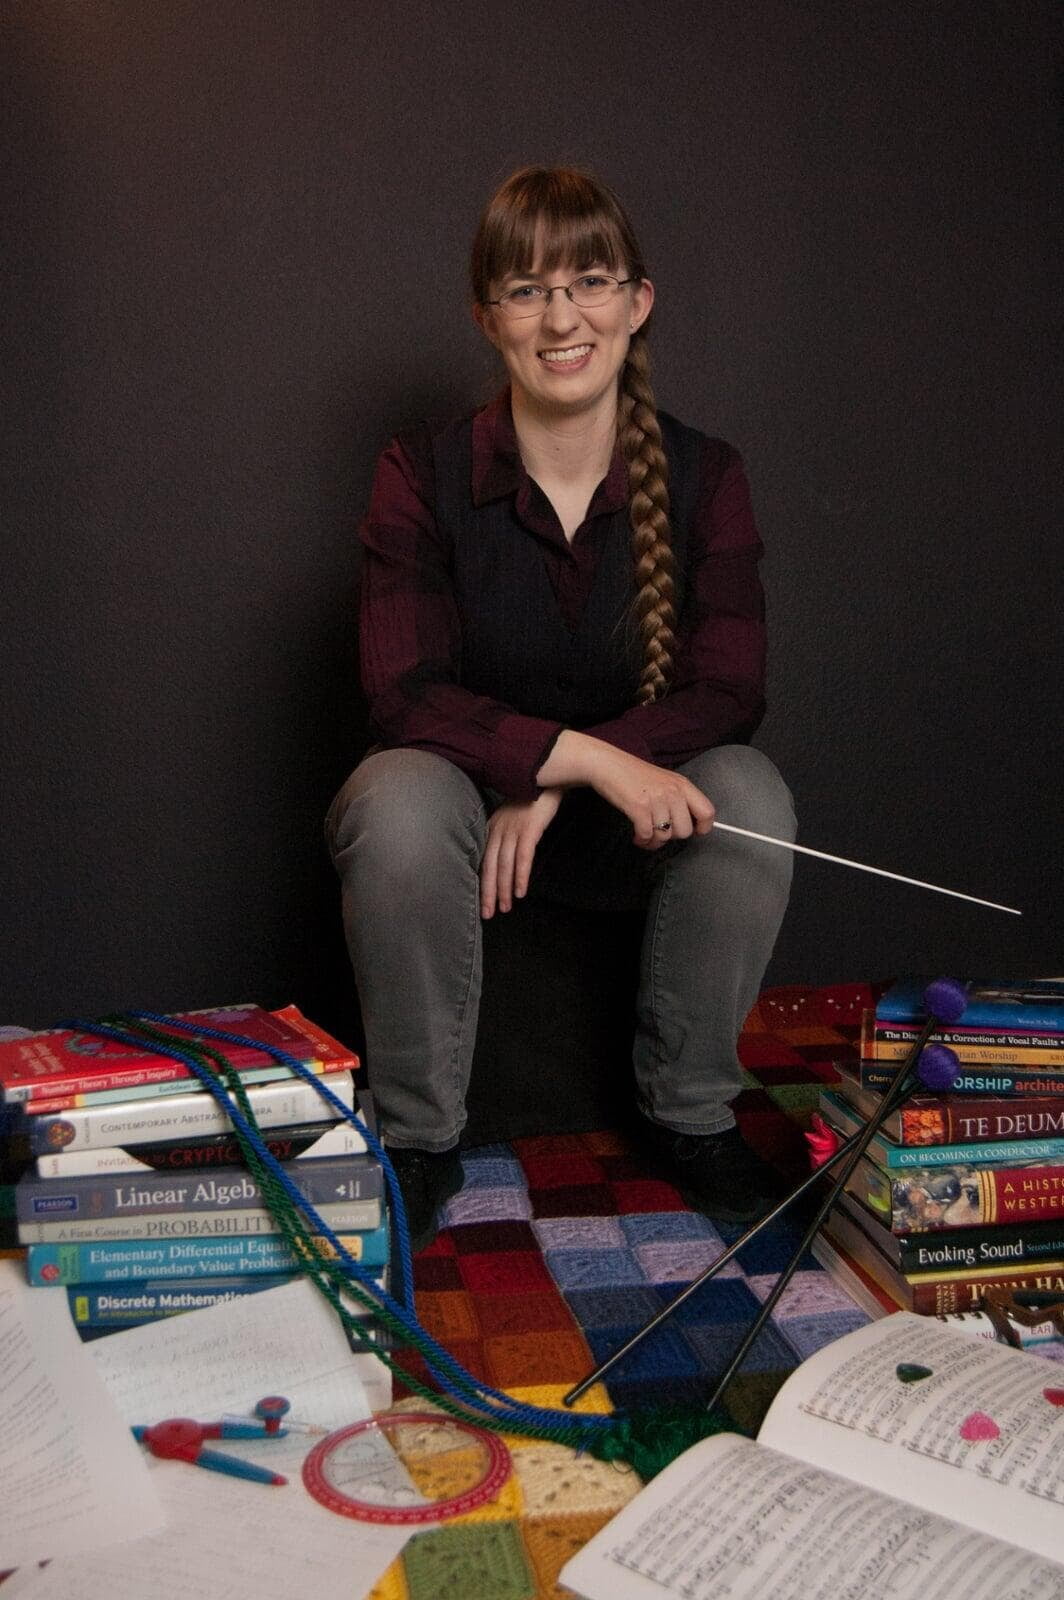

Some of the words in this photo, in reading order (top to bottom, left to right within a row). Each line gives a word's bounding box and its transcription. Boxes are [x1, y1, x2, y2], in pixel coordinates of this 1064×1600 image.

[885, 1031, 900, 1039] The
[902, 1032, 942, 1041] Diagsis
[944, 1033, 951, 1042] &
[952, 1034, 996, 1044] Correction
[997, 1035, 1006, 1043] of
[1008, 1037, 1030, 1045] Vocal
[1032, 1038, 1059, 1046] Faults
[979, 1051, 1018, 1061] Worship
[79, 1077, 107, 1090] Theory
[111, 1072, 145, 1085] Through
[147, 1067, 177, 1081] Inquiry
[953, 1077, 1012, 1090] ORSHIP
[101, 1116, 178, 1133] CONTEMPORARY
[960, 1117, 989, 1137] TE
[996, 1112, 1064, 1135] DEUM
[900, 1153, 916, 1163] ON
[919, 1149, 974, 1162] BECOMING
[976, 1149, 983, 1158] A
[984, 1145, 1050, 1158] CONDUCTOR
[115, 1185, 187, 1208] Linear
[193, 1178, 259, 1204] Algeb
[1004, 1182, 1015, 1194] A
[58, 1230, 66, 1240] A
[146, 1215, 277, 1236] PROBABILITY
[90, 1247, 165, 1265] Elementary
[170, 1242, 243, 1258] Differential
[248, 1240, 288, 1257] Equat
[919, 1245, 976, 1264] Evoking
[980, 1239, 1023, 1259] Sound
[105, 1266, 128, 1278] and
[132, 1262, 195, 1277] Boundary
[200, 1259, 235, 1272] Value
[98, 1295, 156, 1309] Discrete
